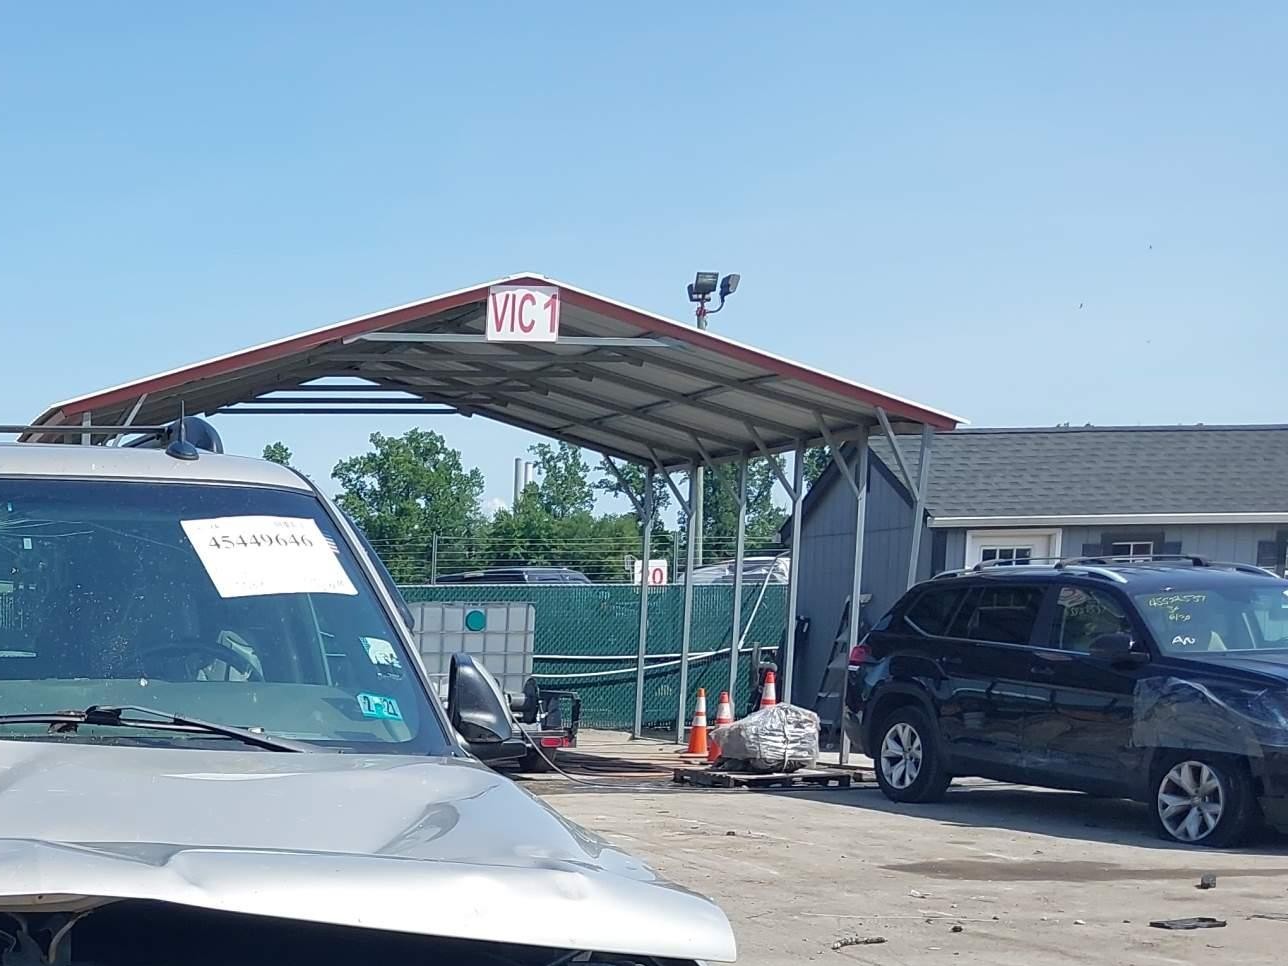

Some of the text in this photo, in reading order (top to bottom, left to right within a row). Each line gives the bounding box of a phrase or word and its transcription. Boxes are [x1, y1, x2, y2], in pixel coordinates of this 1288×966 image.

[491, 293, 557, 333] VIC 1
[208, 533, 313, 549] 45449646
